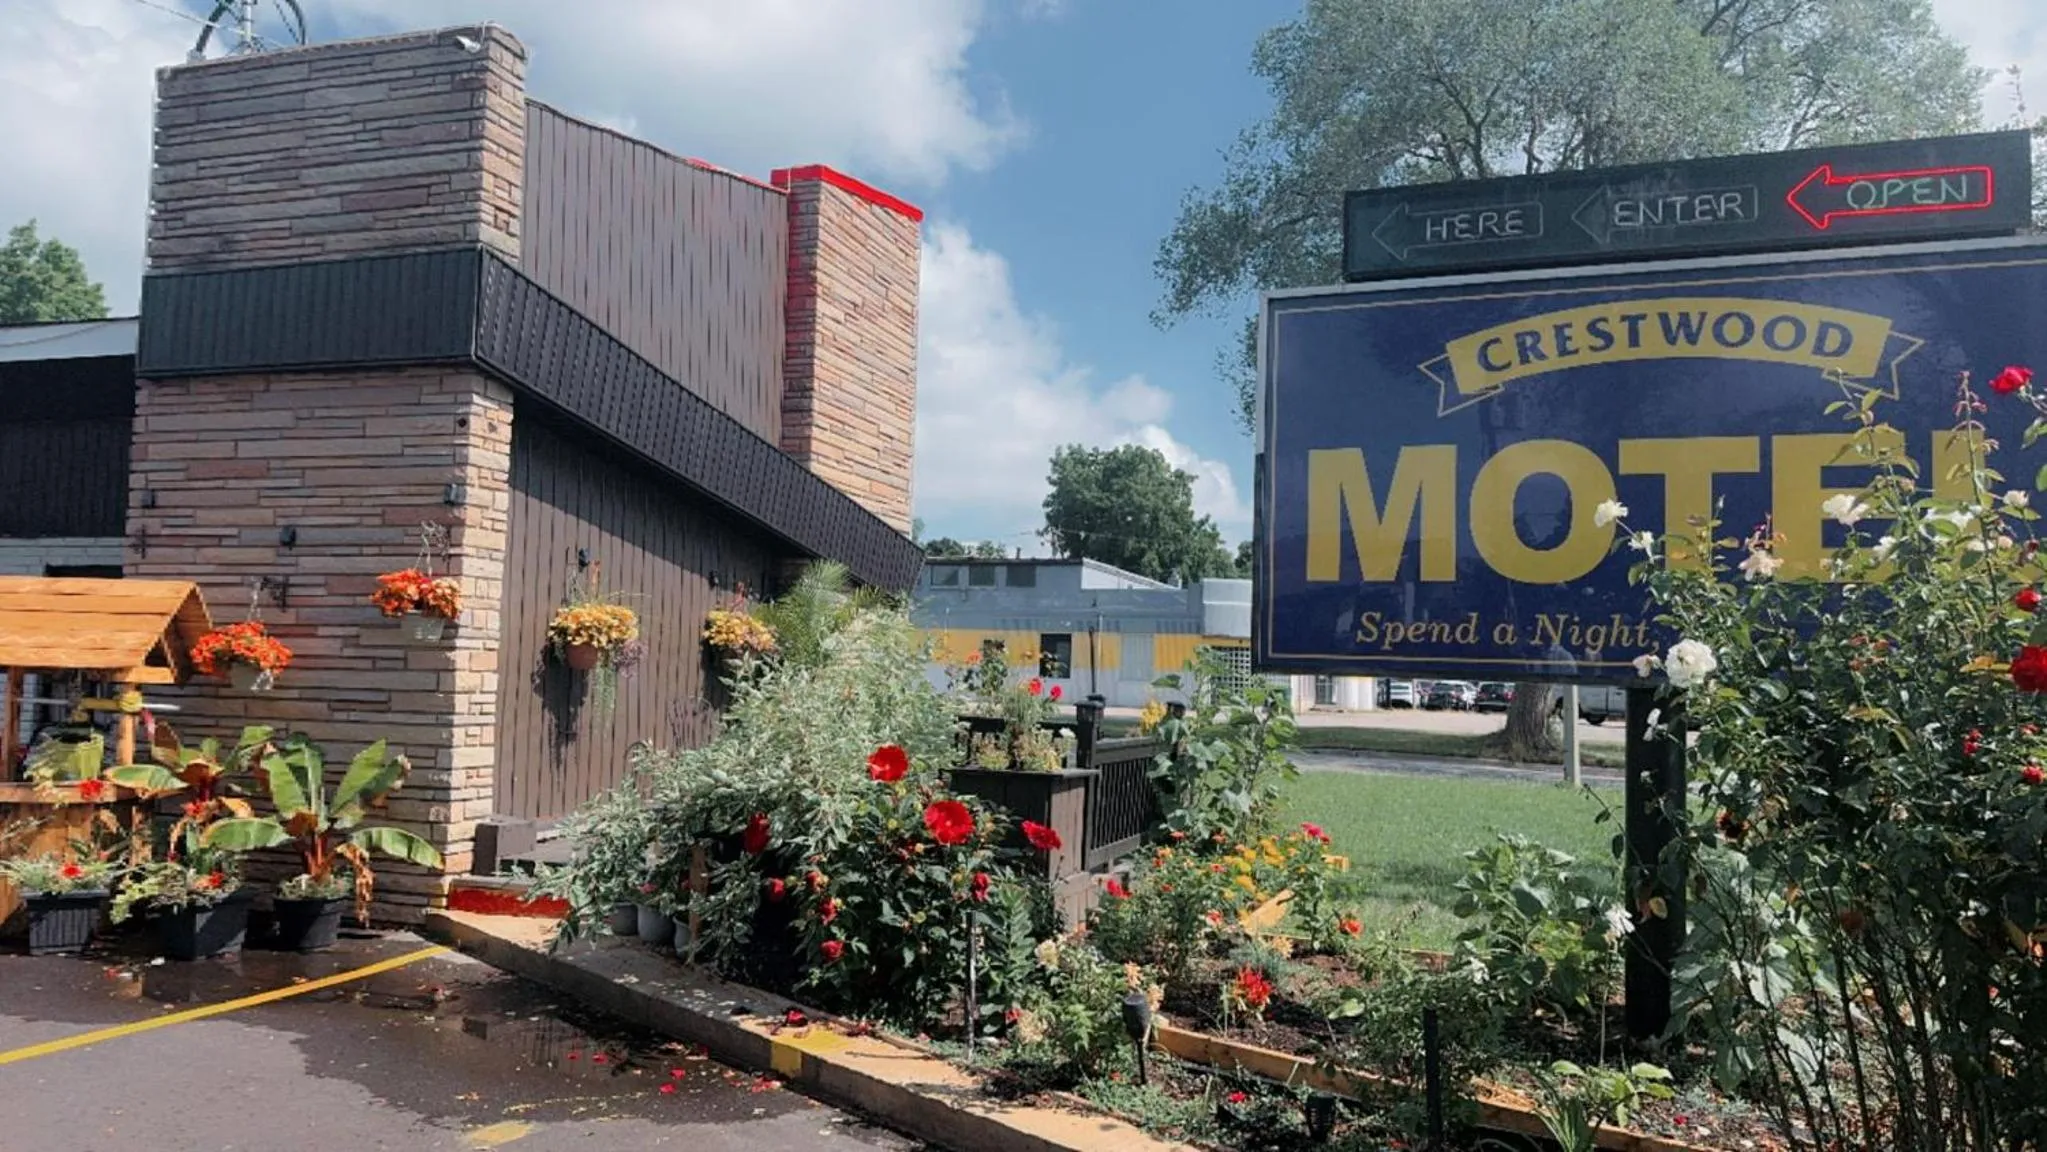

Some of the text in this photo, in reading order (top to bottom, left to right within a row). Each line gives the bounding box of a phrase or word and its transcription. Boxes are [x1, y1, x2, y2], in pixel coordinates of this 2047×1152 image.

[1614, 192, 1745, 228] ENTER
[1846, 173, 1968, 211] OPEN
[1425, 209, 1525, 241] HERE
[1477, 310, 1854, 374] CRESTWOOD
[1356, 611, 1661, 655] Spend a Night,
